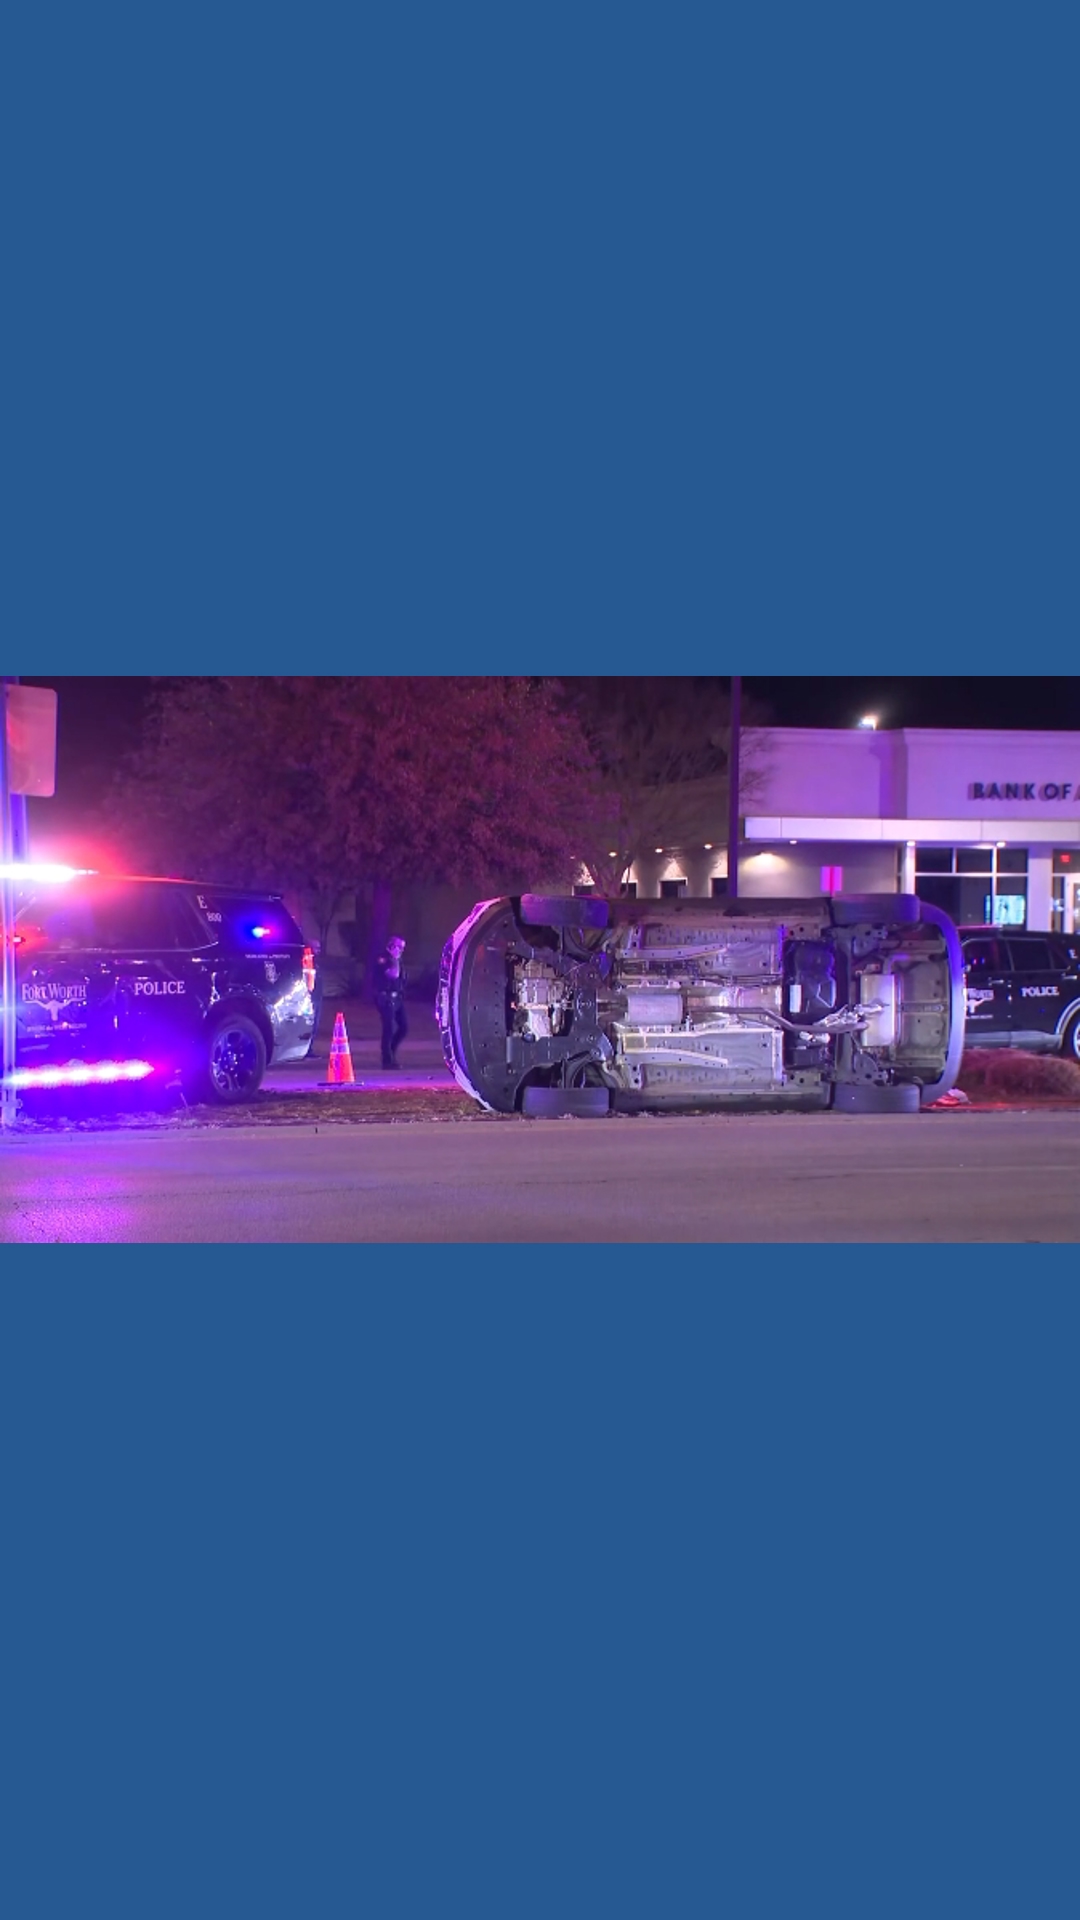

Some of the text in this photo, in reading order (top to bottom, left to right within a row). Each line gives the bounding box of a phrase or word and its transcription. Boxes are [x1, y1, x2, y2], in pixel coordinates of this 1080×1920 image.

[970, 782, 1036, 800] BANK
[1042, 782, 1072, 800] OF
[47, 983, 87, 999] WORTH
[134, 981, 186, 995] POLICE
[1021, 986, 1060, 997] POLICE
